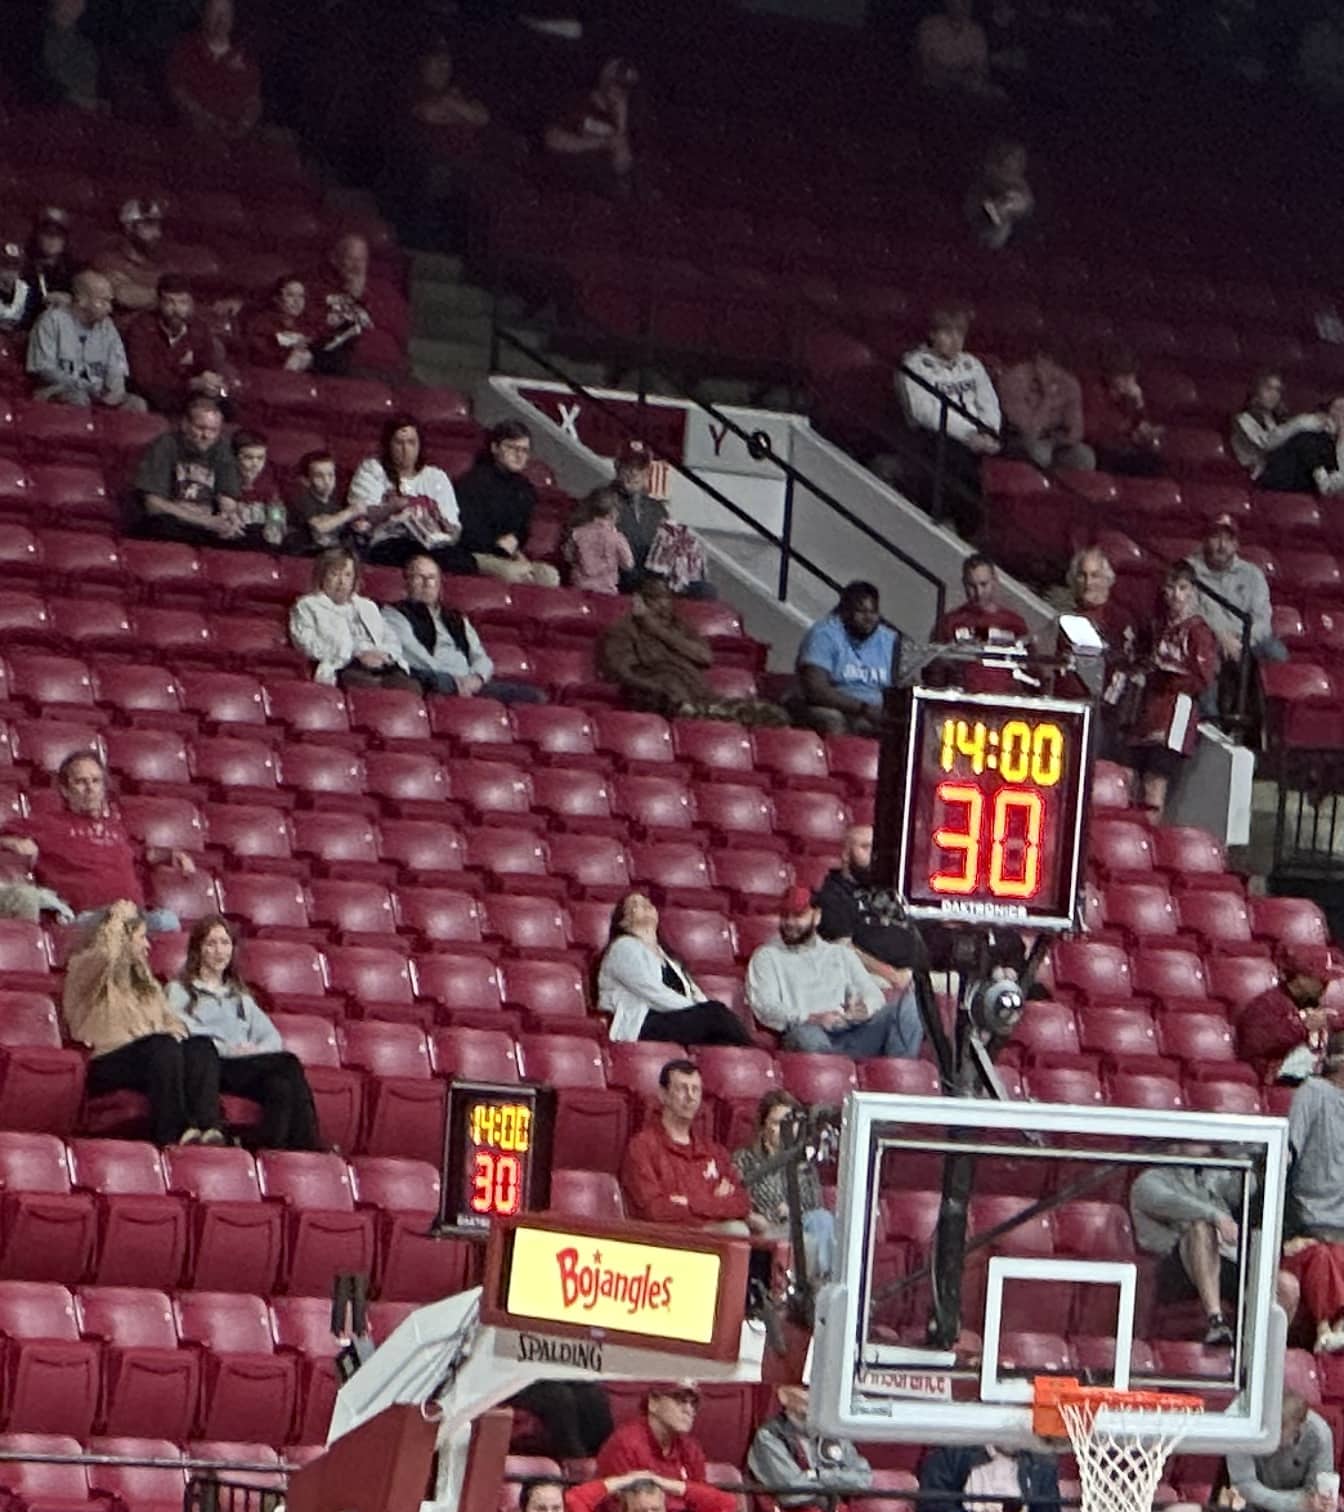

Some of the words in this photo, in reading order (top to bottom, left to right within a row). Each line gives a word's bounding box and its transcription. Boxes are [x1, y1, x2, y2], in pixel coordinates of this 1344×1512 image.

[558, 402, 581, 441] X
[709, 425, 729, 456] Y
[940, 719, 1064, 787] 14:00
[930, 781, 1047, 900] 30
[469, 1101, 531, 1153] 14:00
[471, 1151, 522, 1216] 30
[555, 1246, 674, 1316] Bojangles
[516, 1335, 603, 1373] SPALDING
